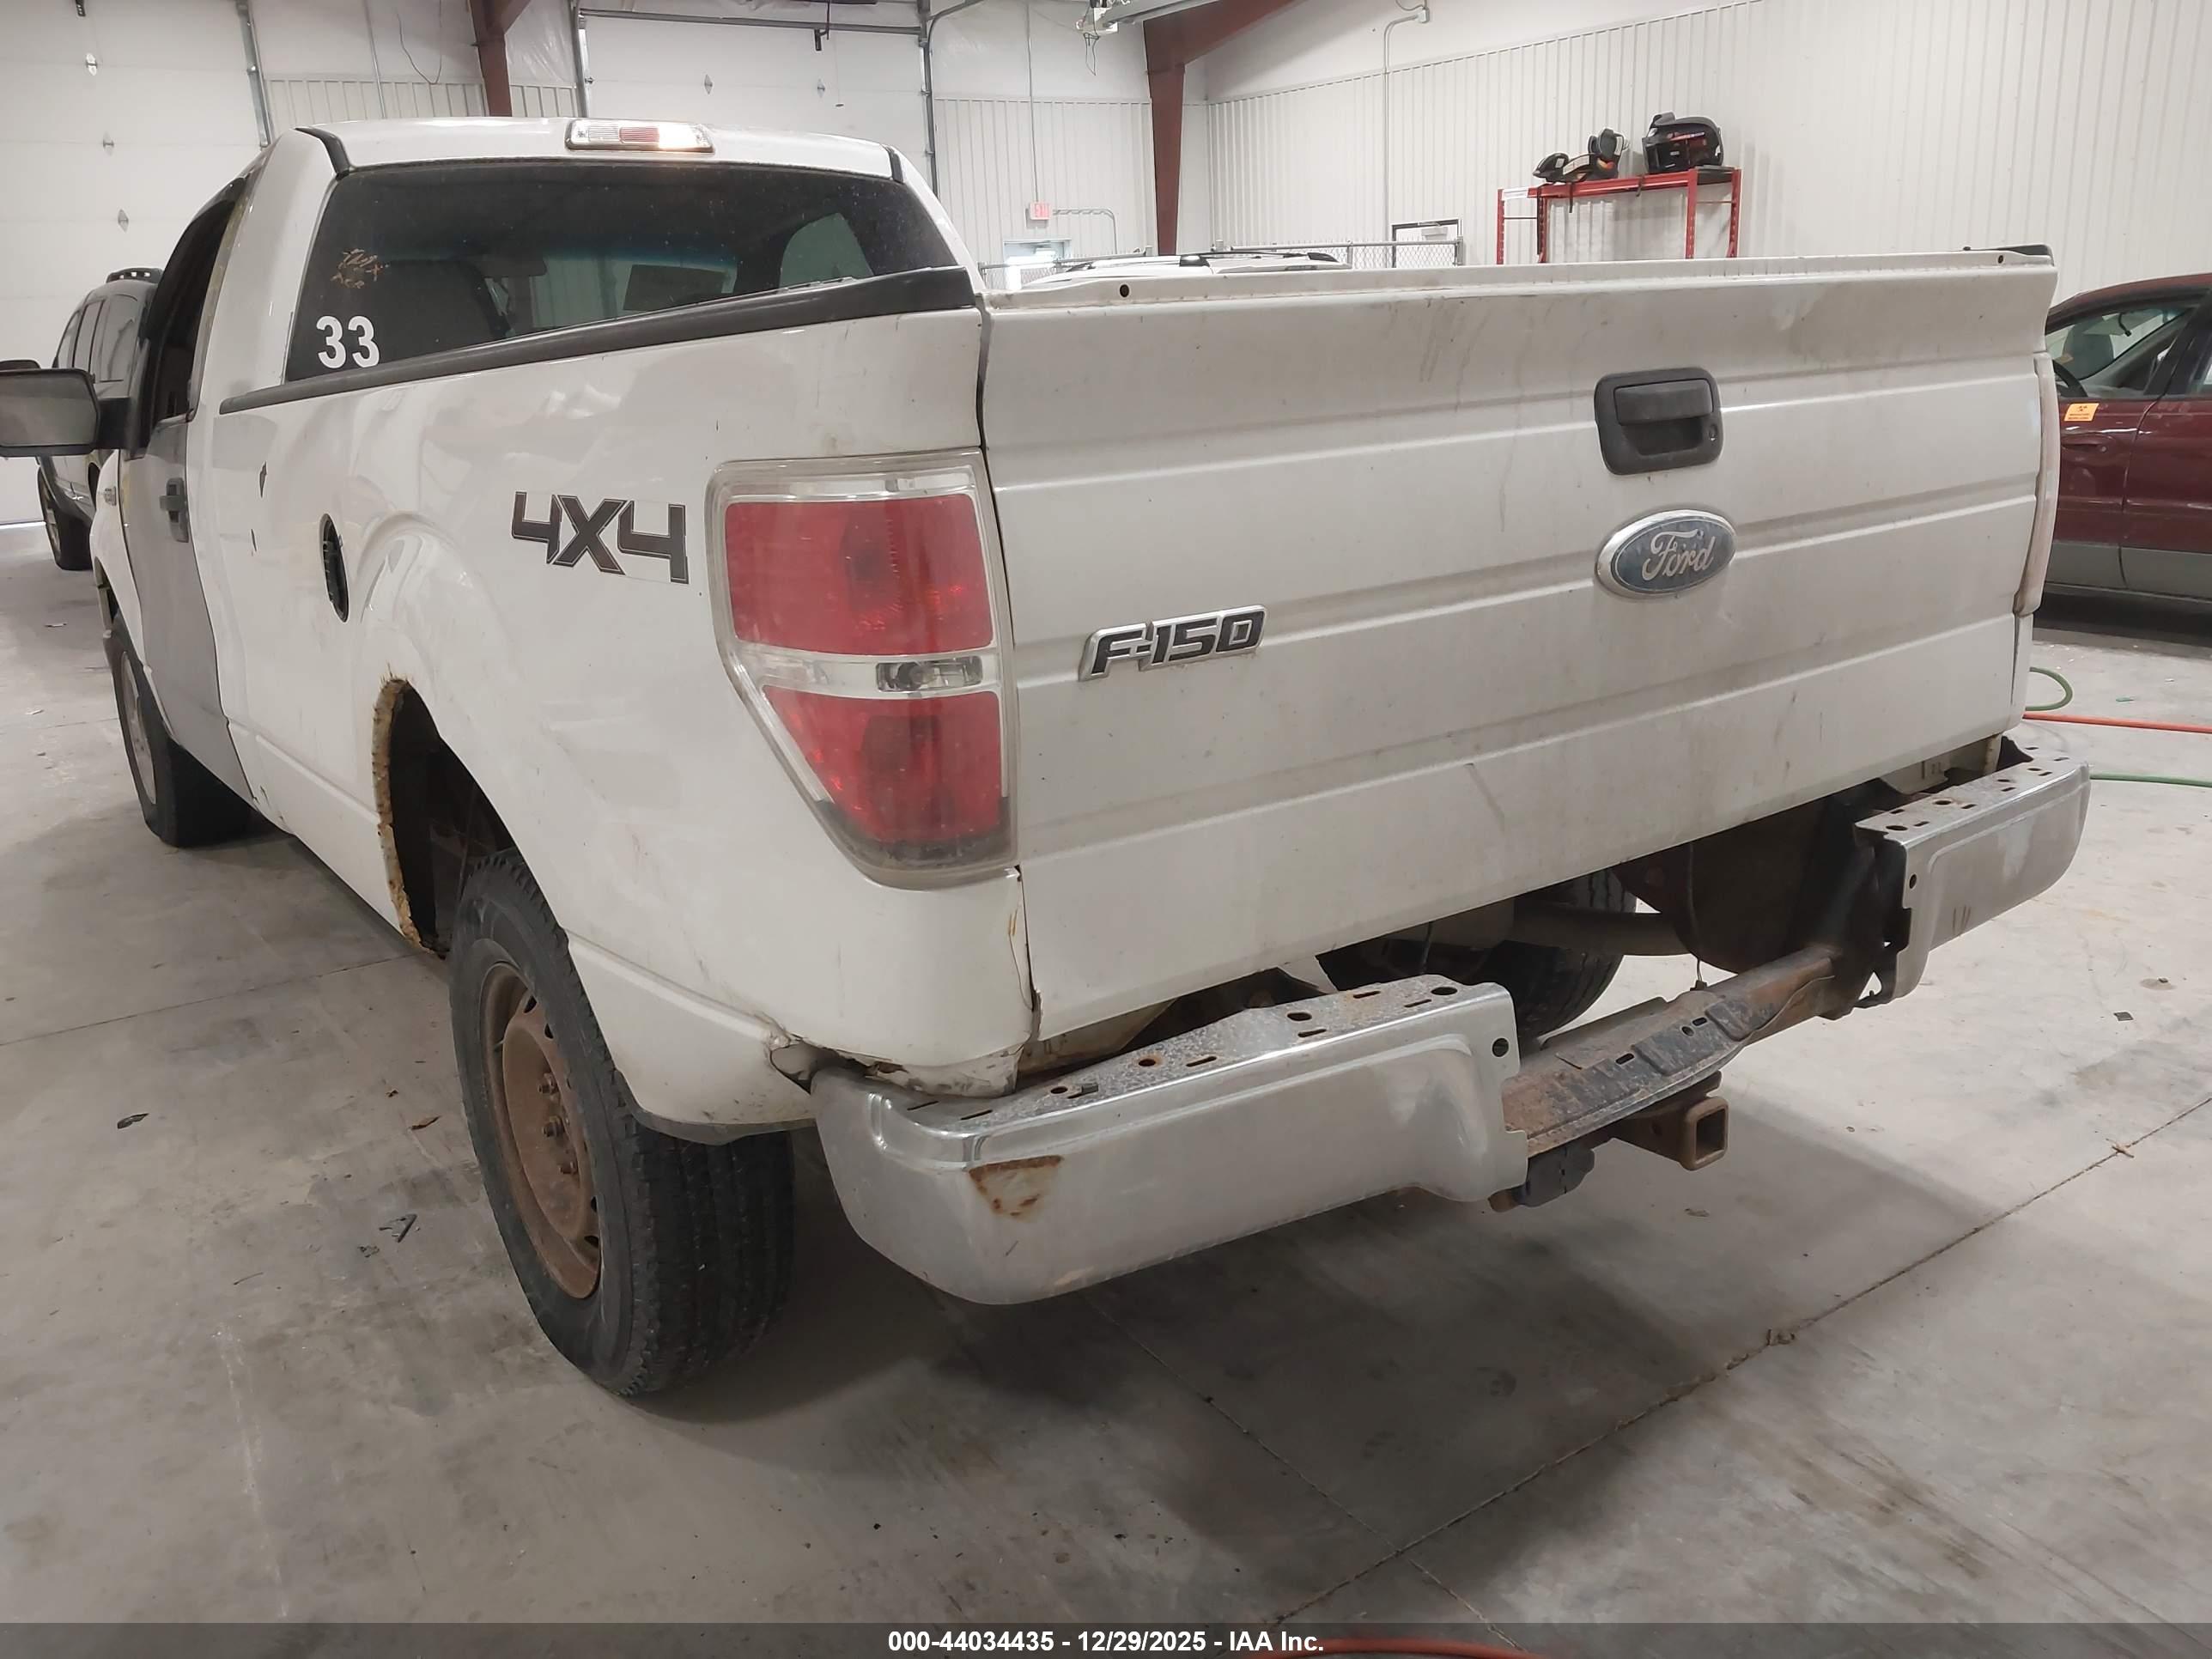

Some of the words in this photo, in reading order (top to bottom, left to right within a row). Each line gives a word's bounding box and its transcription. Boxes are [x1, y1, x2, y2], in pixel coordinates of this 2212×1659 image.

[316, 315, 380, 368] 33
[512, 491, 689, 584] 4X4
[1641, 528, 1716, 581] Ford
[1080, 605, 1264, 680] F-150
